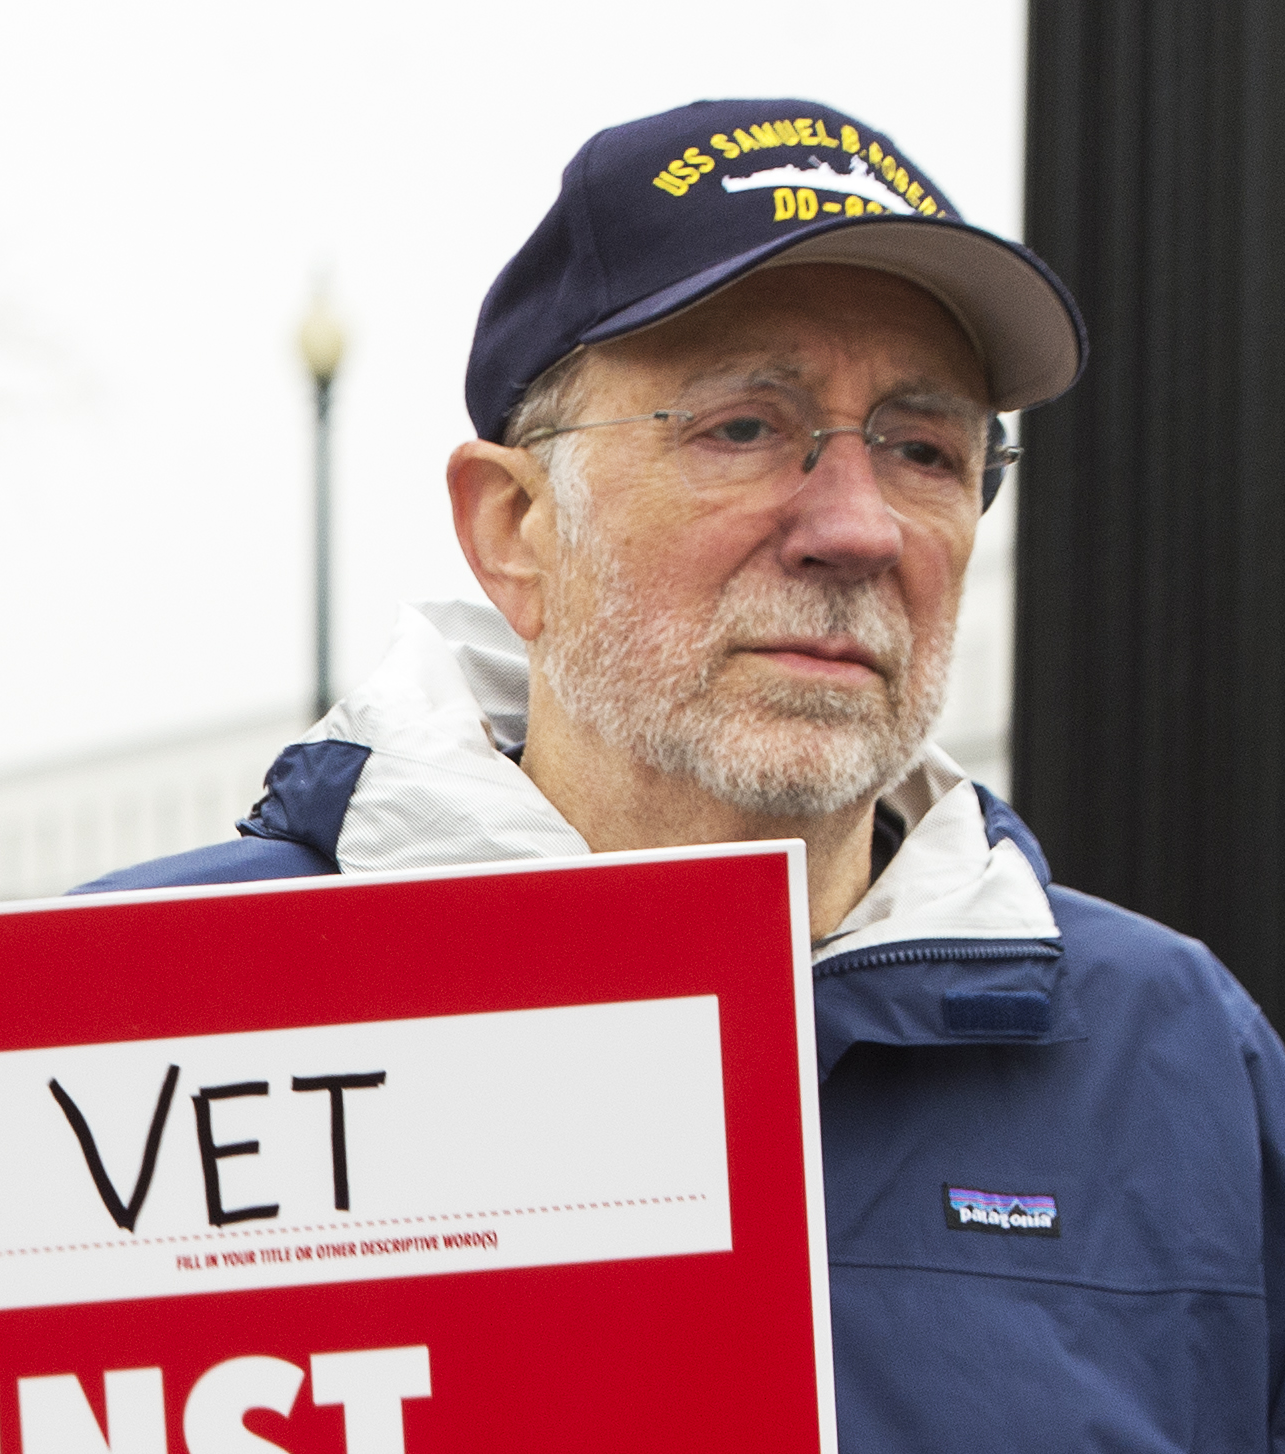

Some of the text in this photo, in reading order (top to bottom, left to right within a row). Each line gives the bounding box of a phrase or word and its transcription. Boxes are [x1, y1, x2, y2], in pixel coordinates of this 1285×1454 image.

[653, 147, 716, 197] USS
[710, 117, 840, 160] SAMUEL
[868, 141, 946, 219] ROBER
[47, 1063, 388, 1234] VET
[176, 1230, 498, 1270] FILL IN YOUR TITLE OR OTHER DESCRIPTIVE WORD(S)
[958, 1206, 1054, 1229] patagonia
